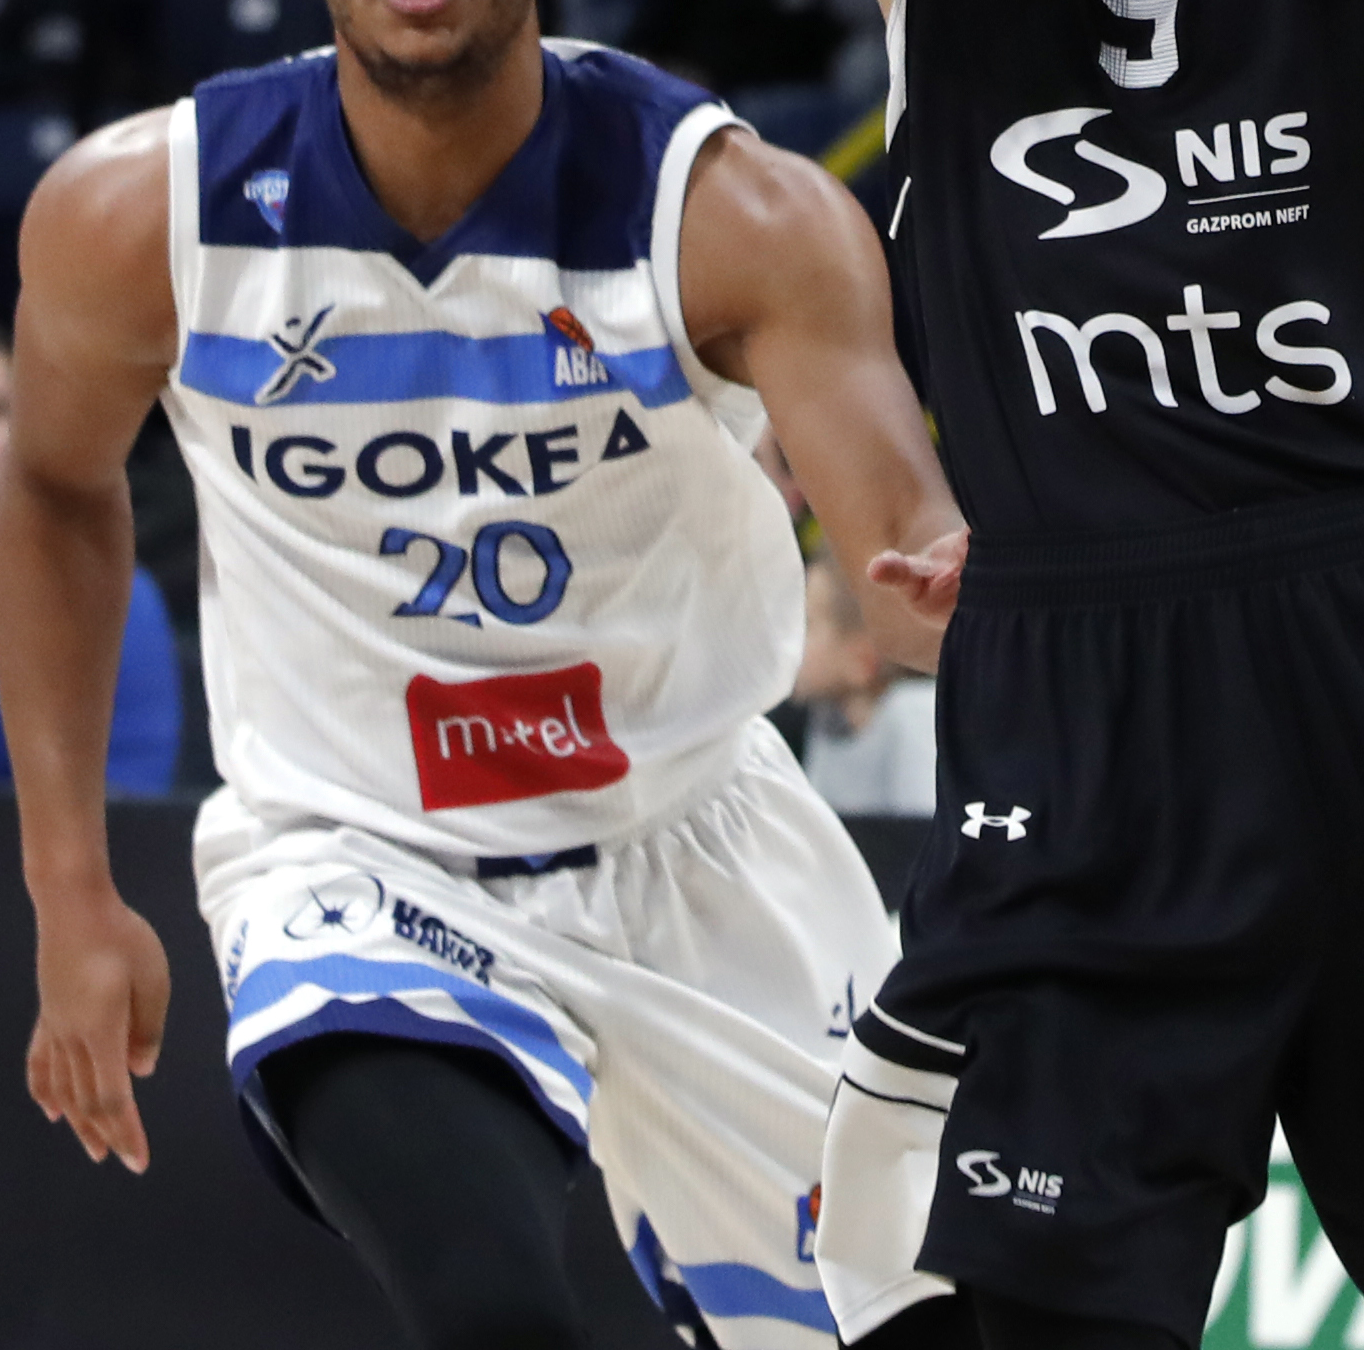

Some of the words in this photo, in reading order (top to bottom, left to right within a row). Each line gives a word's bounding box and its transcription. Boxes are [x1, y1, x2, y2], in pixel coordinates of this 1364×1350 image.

[1175, 111, 1311, 187] NIS
[1186, 210, 1272, 234] GAZPROM
[1275, 204, 1310, 226] NEFT
[555, 345, 608, 387] ABA
[1015, 284, 1353, 416] mts
[230, 409, 650, 498] IGOKEA
[379, 520, 573, 628] 20
[1018, 1166, 1063, 1198] NIS
